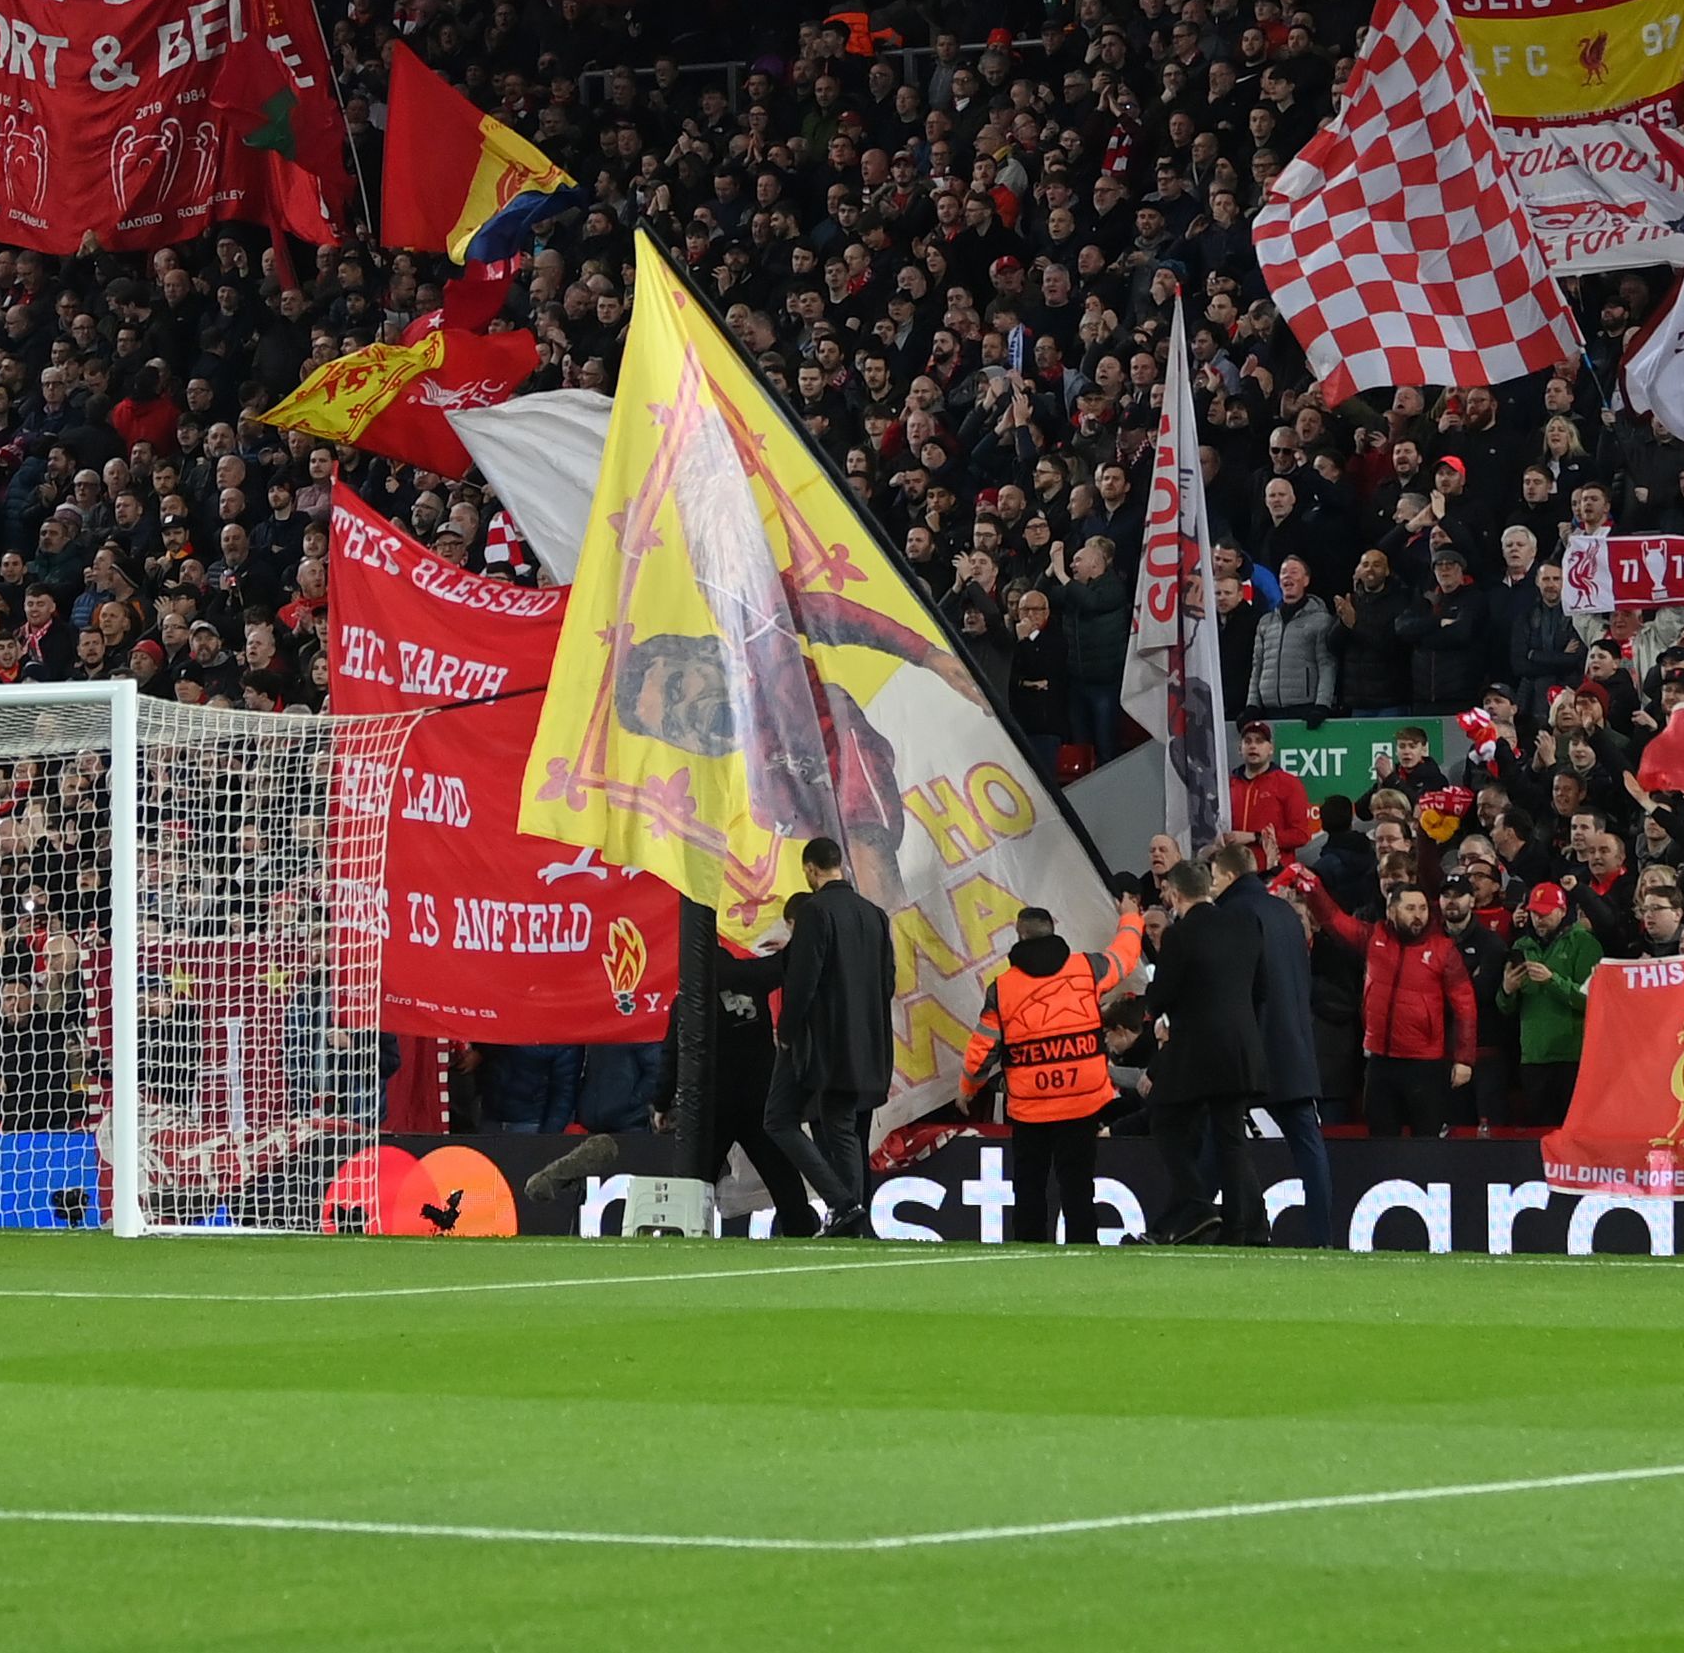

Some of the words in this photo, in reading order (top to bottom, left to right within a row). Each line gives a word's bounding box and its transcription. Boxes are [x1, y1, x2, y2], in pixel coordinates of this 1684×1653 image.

[1640, 14, 1683, 57] 97
[89, 35, 141, 92] &
[135, 101, 163, 121] 2019
[175, 88, 206, 106] 1984
[8, 207, 50, 230] ISTANBUL
[117, 212, 163, 231] MADRID
[177, 202, 207, 219] ROME
[331, 504, 402, 576] THIS
[411, 557, 561, 617] BLESSED
[1619, 559, 1639, 583] 77
[398, 640, 509, 706] EARTH
[1279, 748, 1348, 777] EXIT
[401, 767, 472, 828] LAND
[406, 891, 440, 946] IS
[452, 901, 593, 953] ANFIELD
[384, 994, 412, 1006] Euro
[1009, 1032, 1099, 1067] STEWARD
[1034, 1067, 1080, 1091] 087
